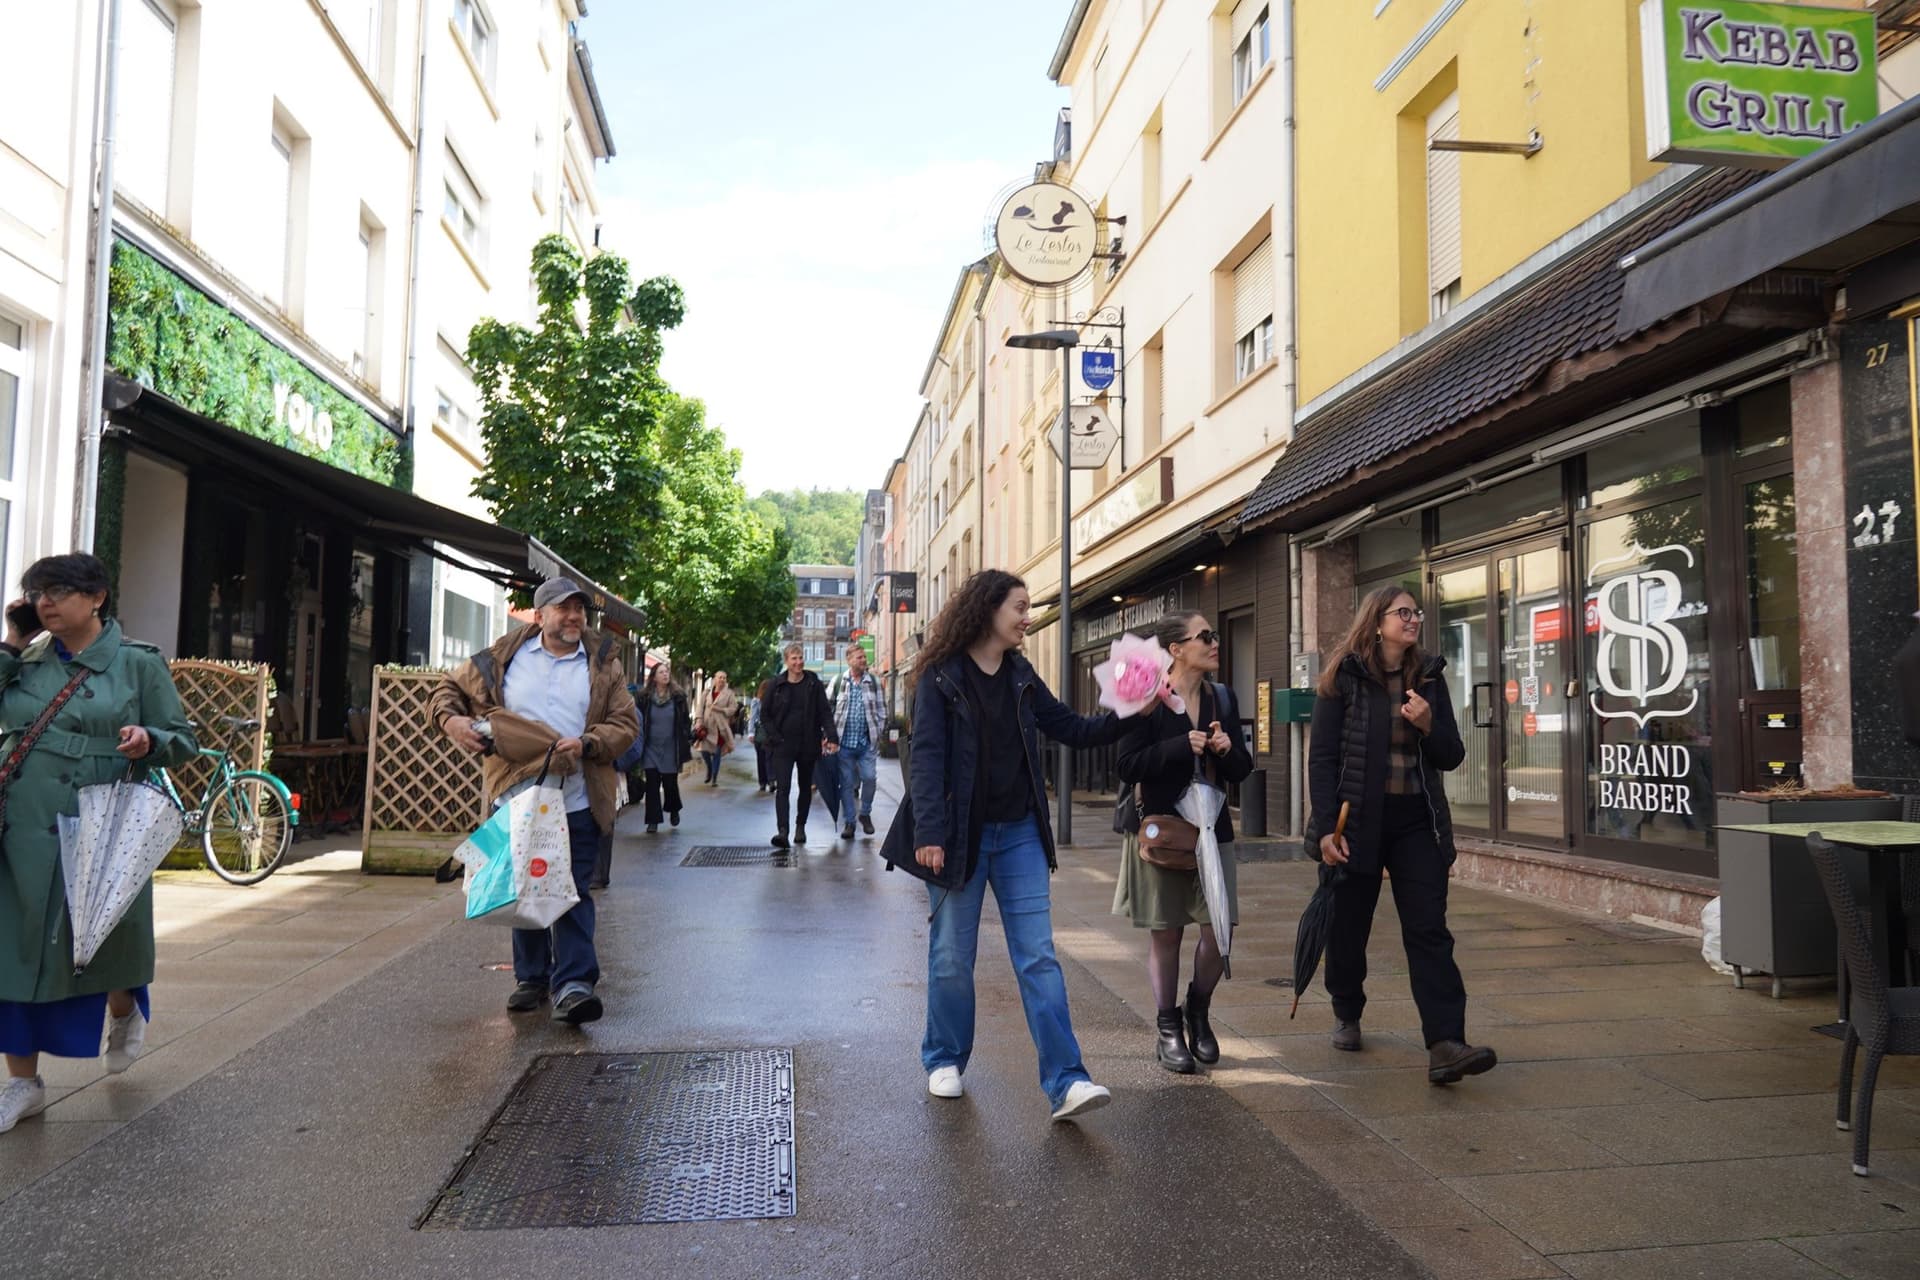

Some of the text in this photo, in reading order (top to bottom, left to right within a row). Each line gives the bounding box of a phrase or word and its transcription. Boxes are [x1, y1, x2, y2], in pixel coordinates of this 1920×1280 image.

[1680, 9, 1859, 72] KEBAB
[1687, 81, 1861, 140] GRILL
[1015, 234, 1033, 253] Le
[1866, 343, 1890, 369] 27
[273, 382, 334, 453] YOLO
[1853, 499, 1902, 548] 27
[1123, 595, 1166, 632] STEAKHOUSE
[1600, 744, 1691, 778] BRAND
[1600, 780, 1694, 815] BARBER
